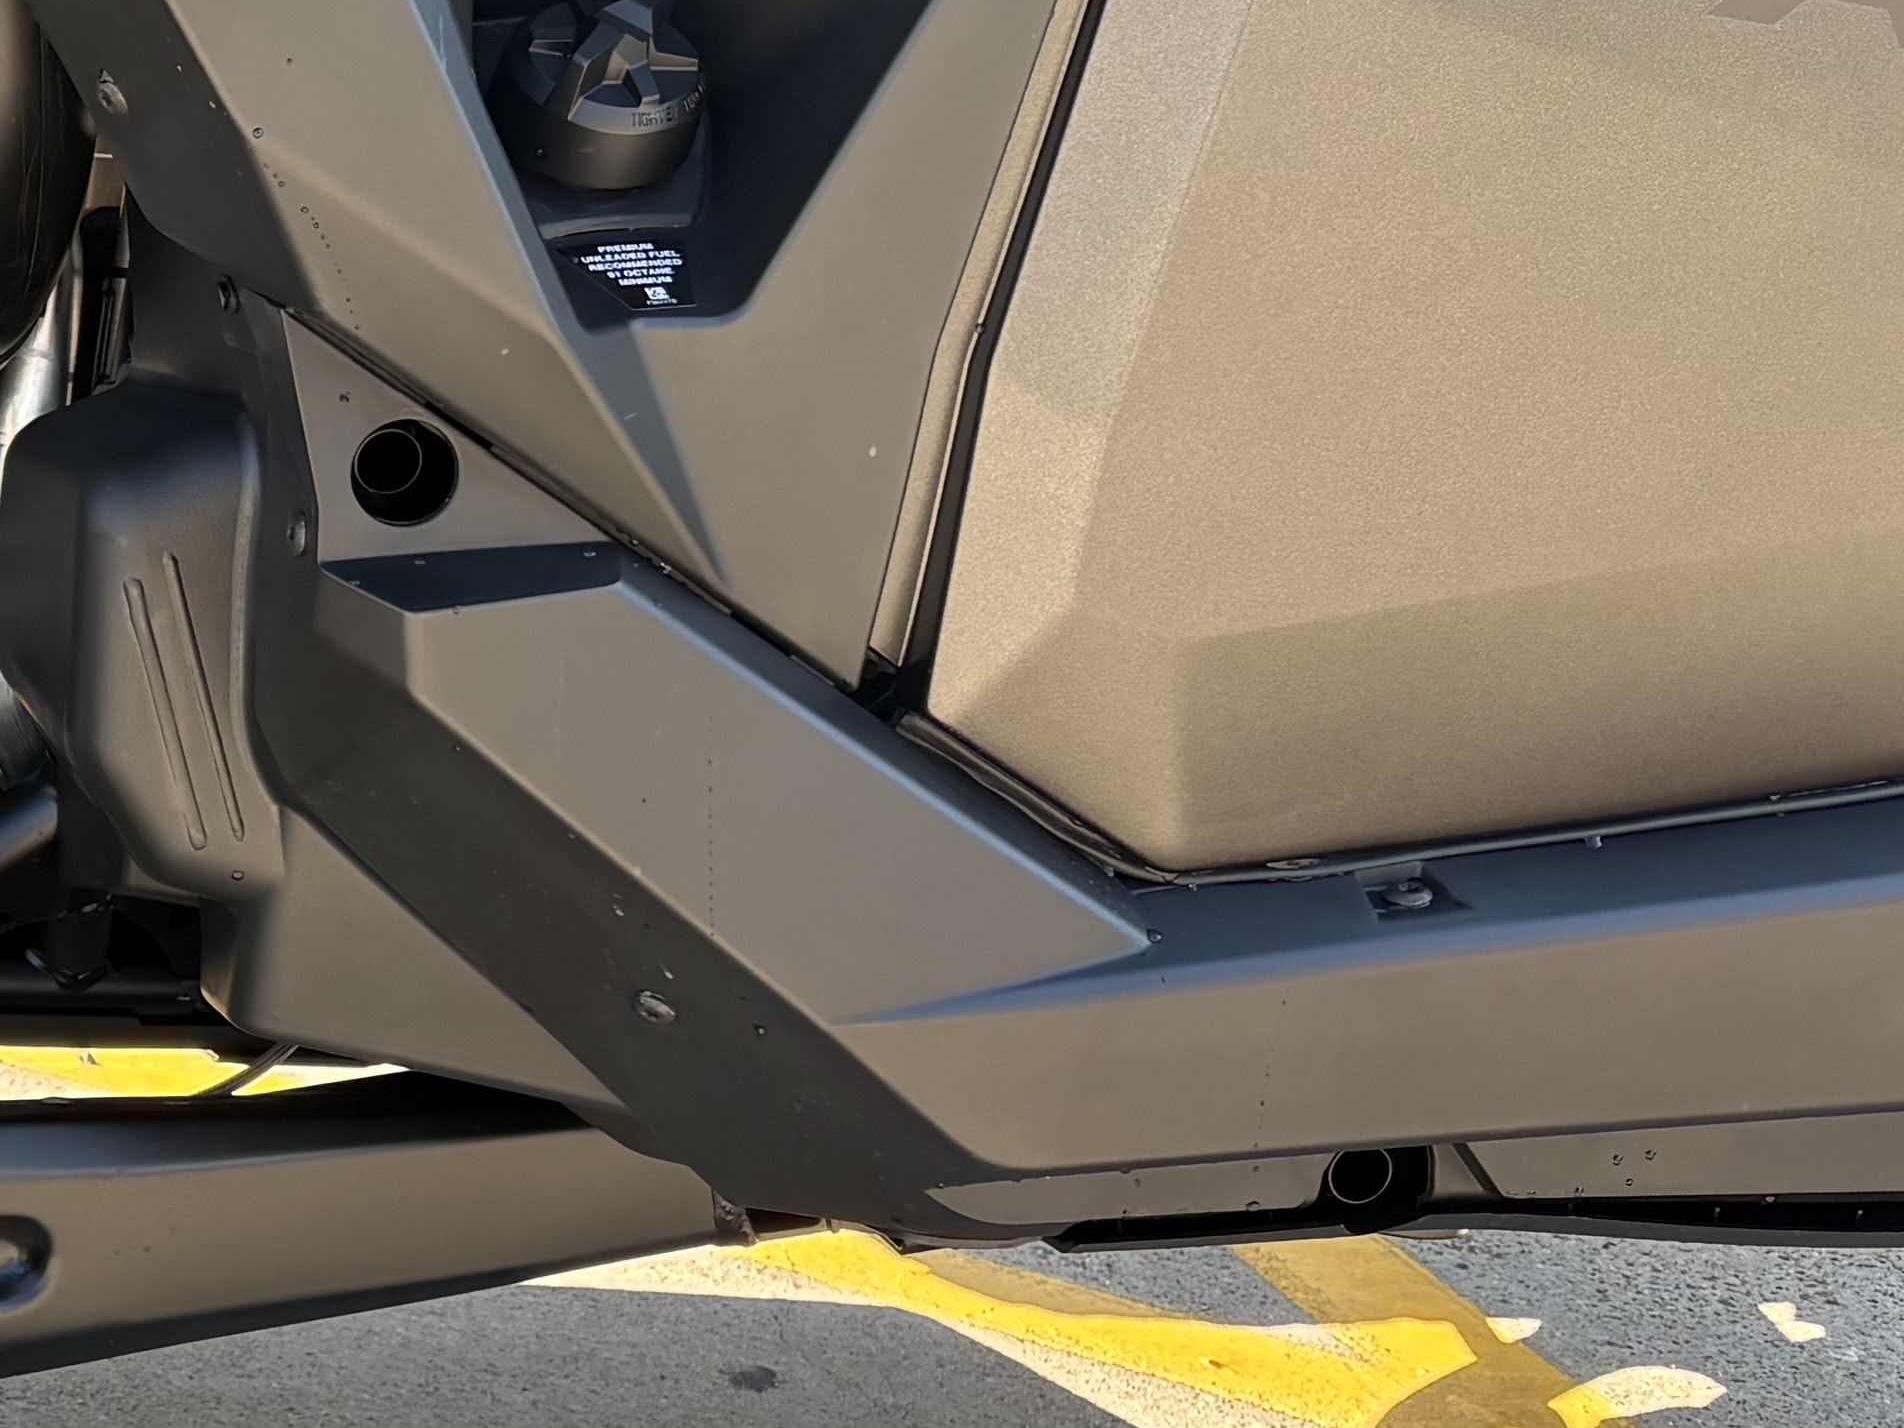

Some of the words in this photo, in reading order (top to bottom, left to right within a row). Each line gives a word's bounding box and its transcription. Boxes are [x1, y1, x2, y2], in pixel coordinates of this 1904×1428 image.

[596, 242, 655, 254] PREMIUM
[580, 251, 647, 264] UNLEADED
[647, 249, 681, 259] FUEL
[587, 258, 683, 272] RECOMMENDED
[606, 271, 621, 279] 91
[622, 267, 676, 278] OCTANE
[617, 275, 673, 286] MINIMUM
